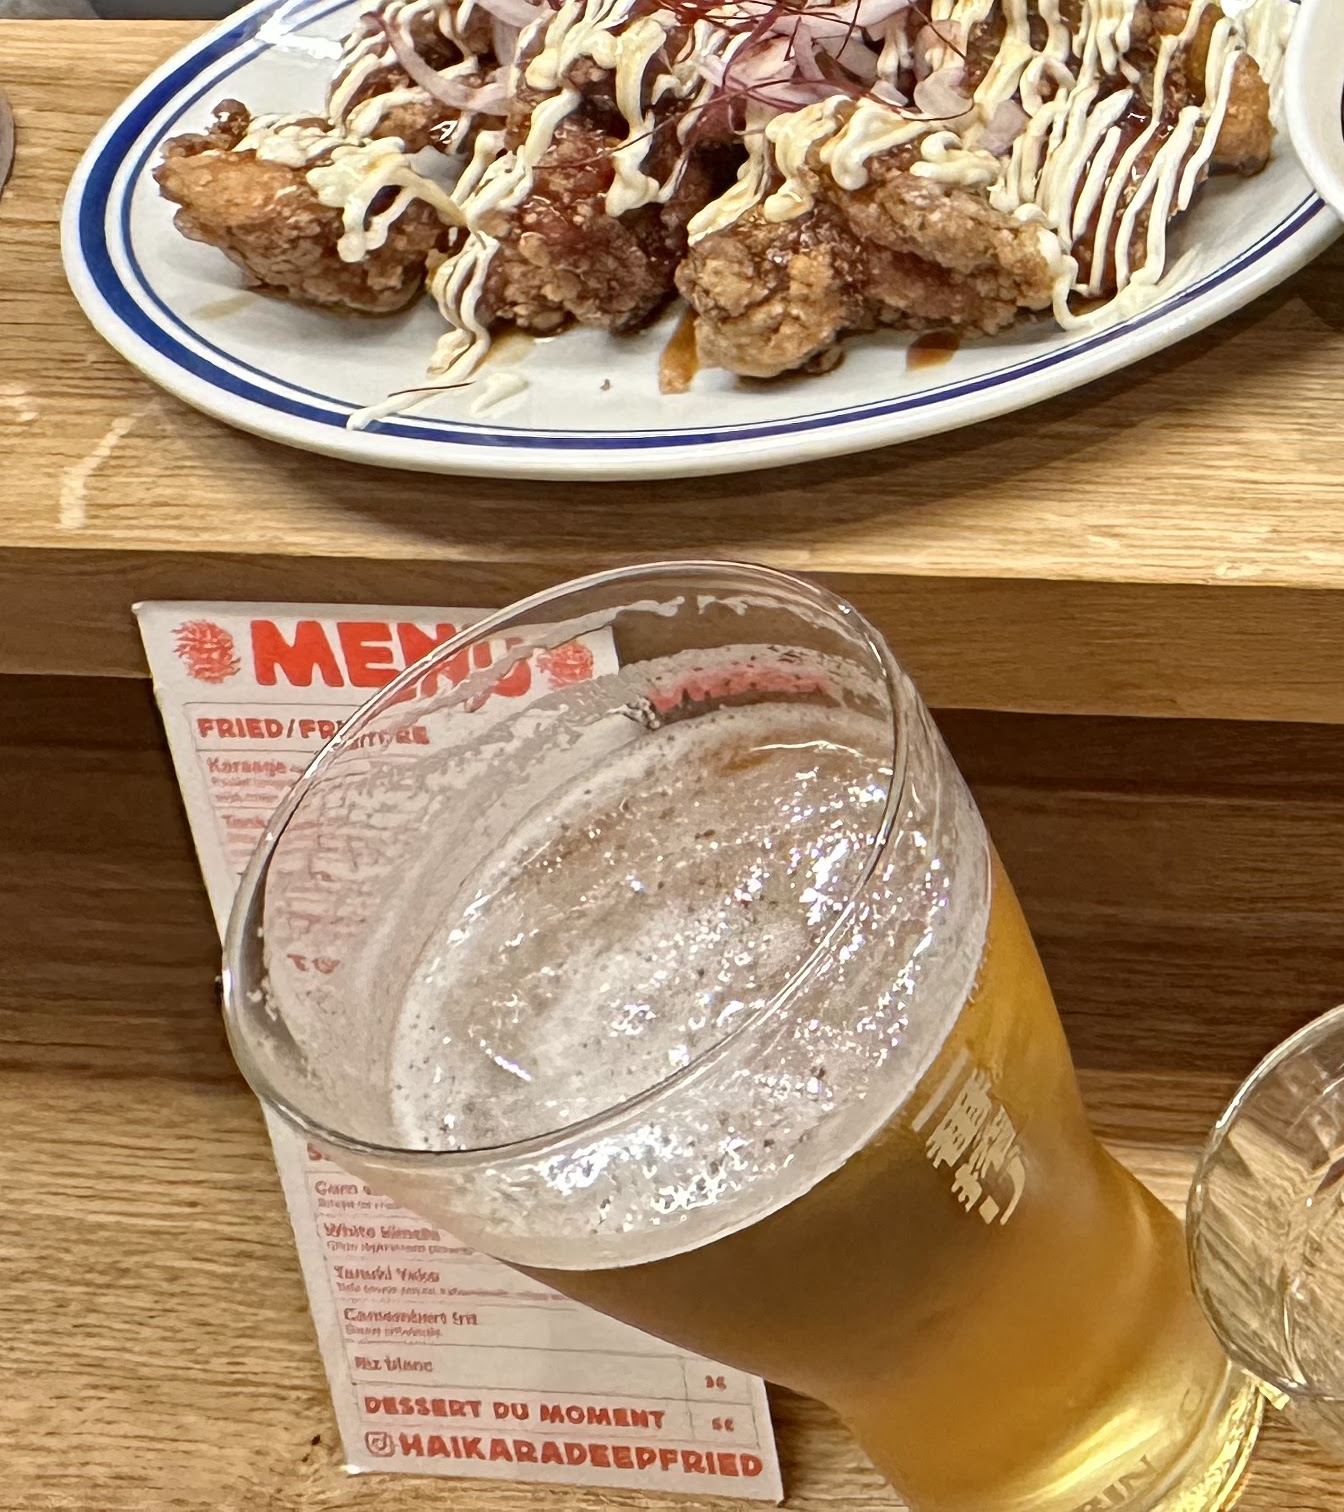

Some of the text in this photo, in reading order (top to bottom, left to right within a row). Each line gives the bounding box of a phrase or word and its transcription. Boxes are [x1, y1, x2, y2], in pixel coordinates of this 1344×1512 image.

[251, 619, 532, 698] MENU
[364, 1396, 666, 1430] DESSERT DU MOMENT
[398, 1431, 764, 1478] HAIKARADEEPFRIED
